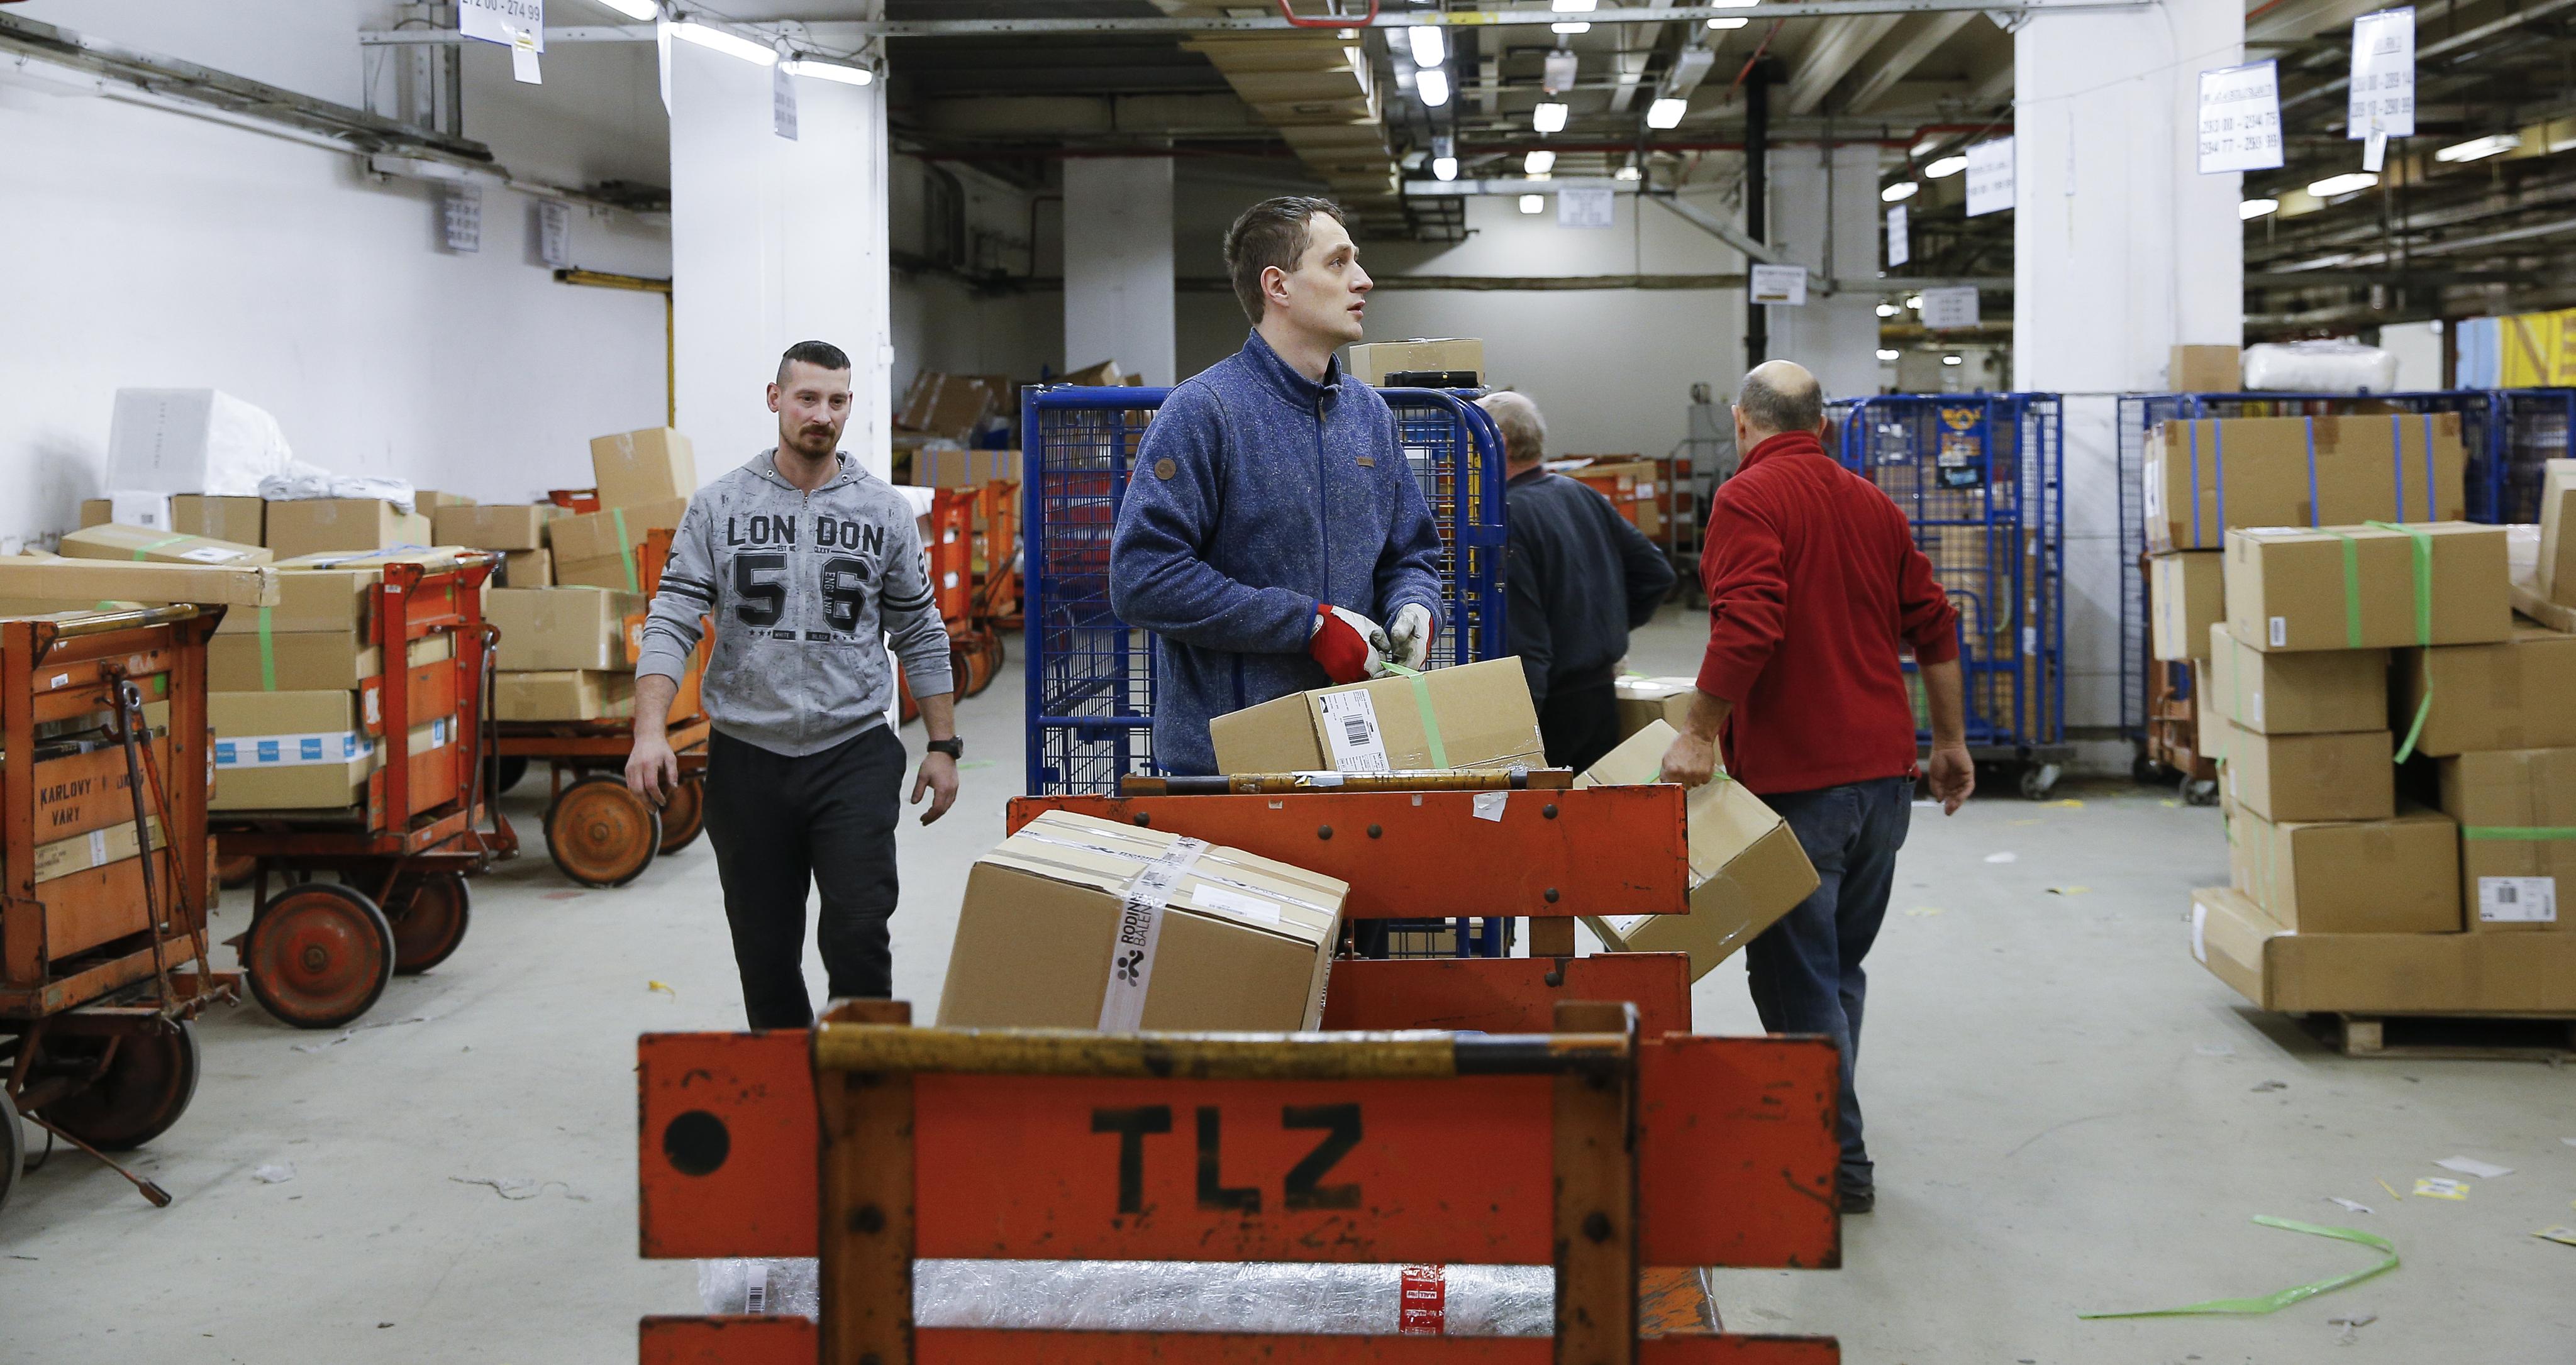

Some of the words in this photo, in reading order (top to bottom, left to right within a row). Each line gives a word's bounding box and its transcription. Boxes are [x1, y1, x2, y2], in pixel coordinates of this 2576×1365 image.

[508, 0, 525, 18] 274
[528, 5, 540, 21] 99
[728, 515, 796, 546] LON
[816, 516, 885, 556] DON
[734, 553, 787, 628] 5
[820, 556, 871, 633] 6
[40, 779, 92, 807] KARLOVY
[52, 806, 80, 826] VARY
[1133, 901, 1152, 947] BALEN
[1091, 1103, 1363, 1215] TLZ
